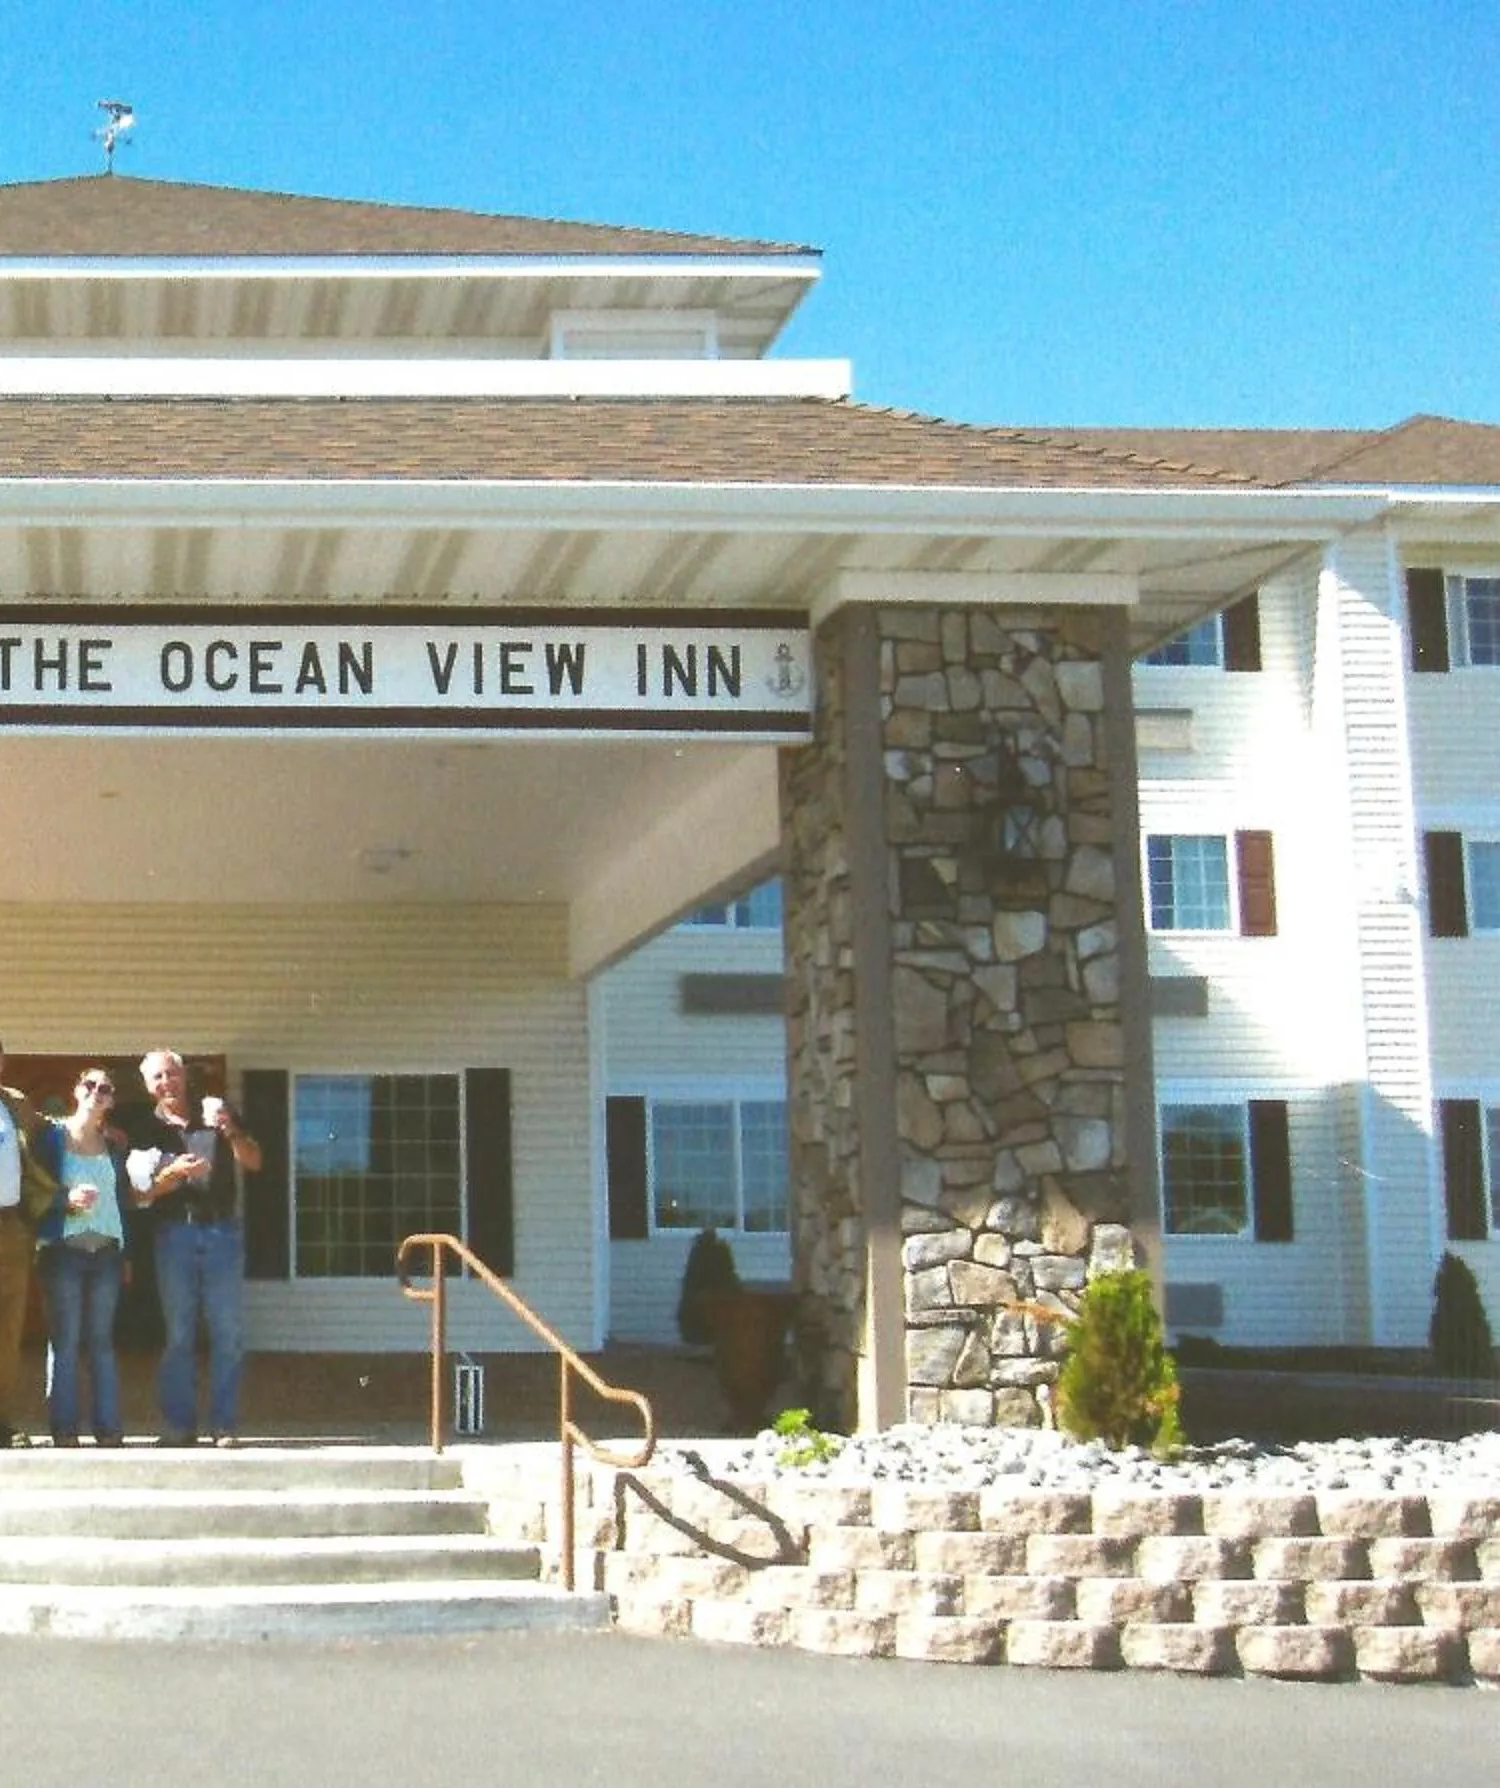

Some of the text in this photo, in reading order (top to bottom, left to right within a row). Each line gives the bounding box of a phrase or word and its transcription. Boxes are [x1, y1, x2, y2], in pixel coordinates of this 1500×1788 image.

[160, 639, 374, 696] OCEAN
[425, 640, 587, 697] VIEW
[636, 642, 742, 700] INN
